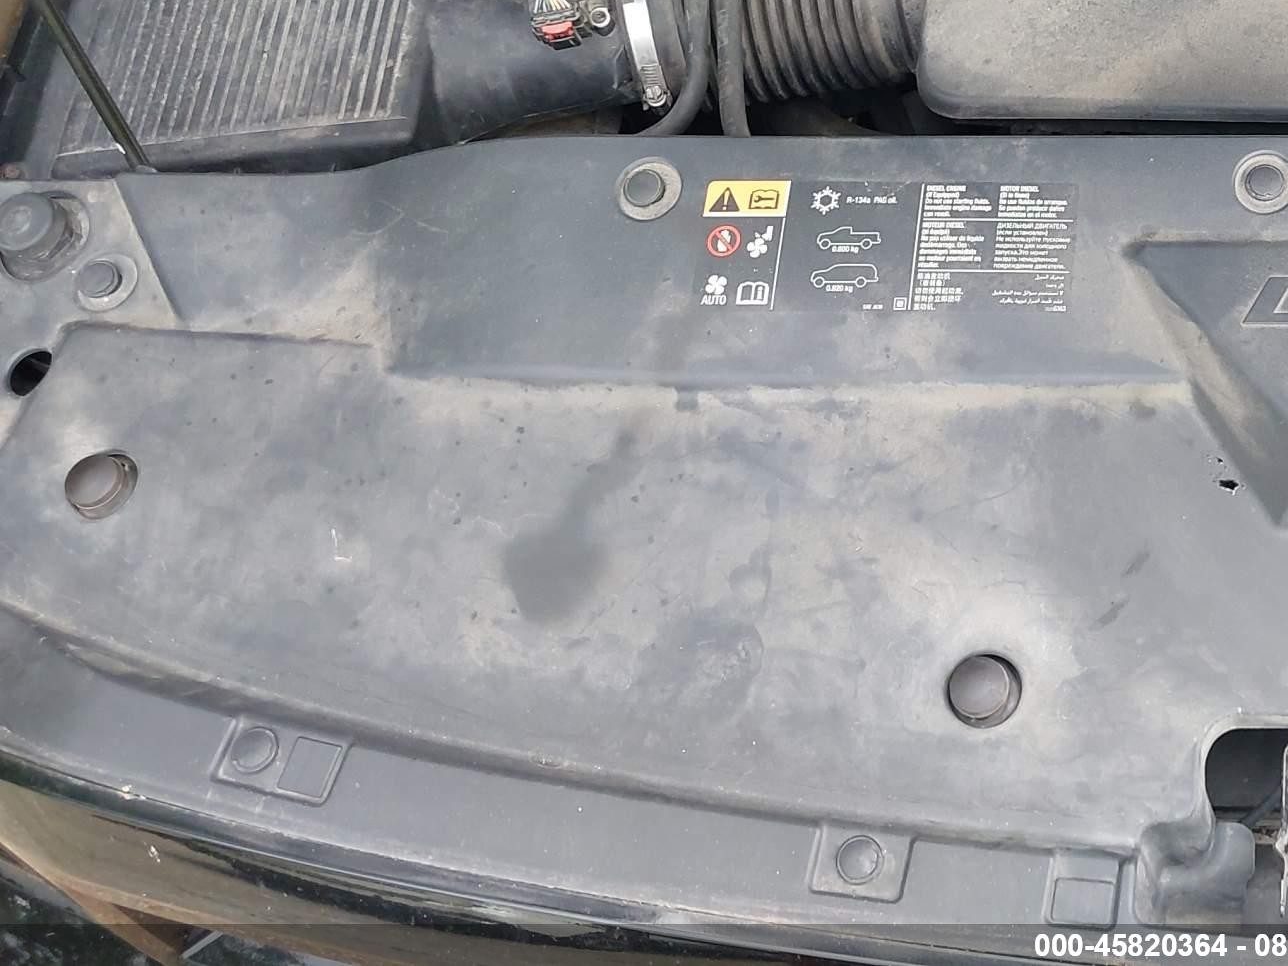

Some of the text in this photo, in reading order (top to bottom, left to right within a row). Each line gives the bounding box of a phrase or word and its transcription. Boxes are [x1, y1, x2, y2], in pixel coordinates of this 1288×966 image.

[846, 196, 871, 204] R-134a
[850, 246, 859, 254] kg
[844, 285, 854, 293] kg
[700, 294, 727, 305] AUTO
